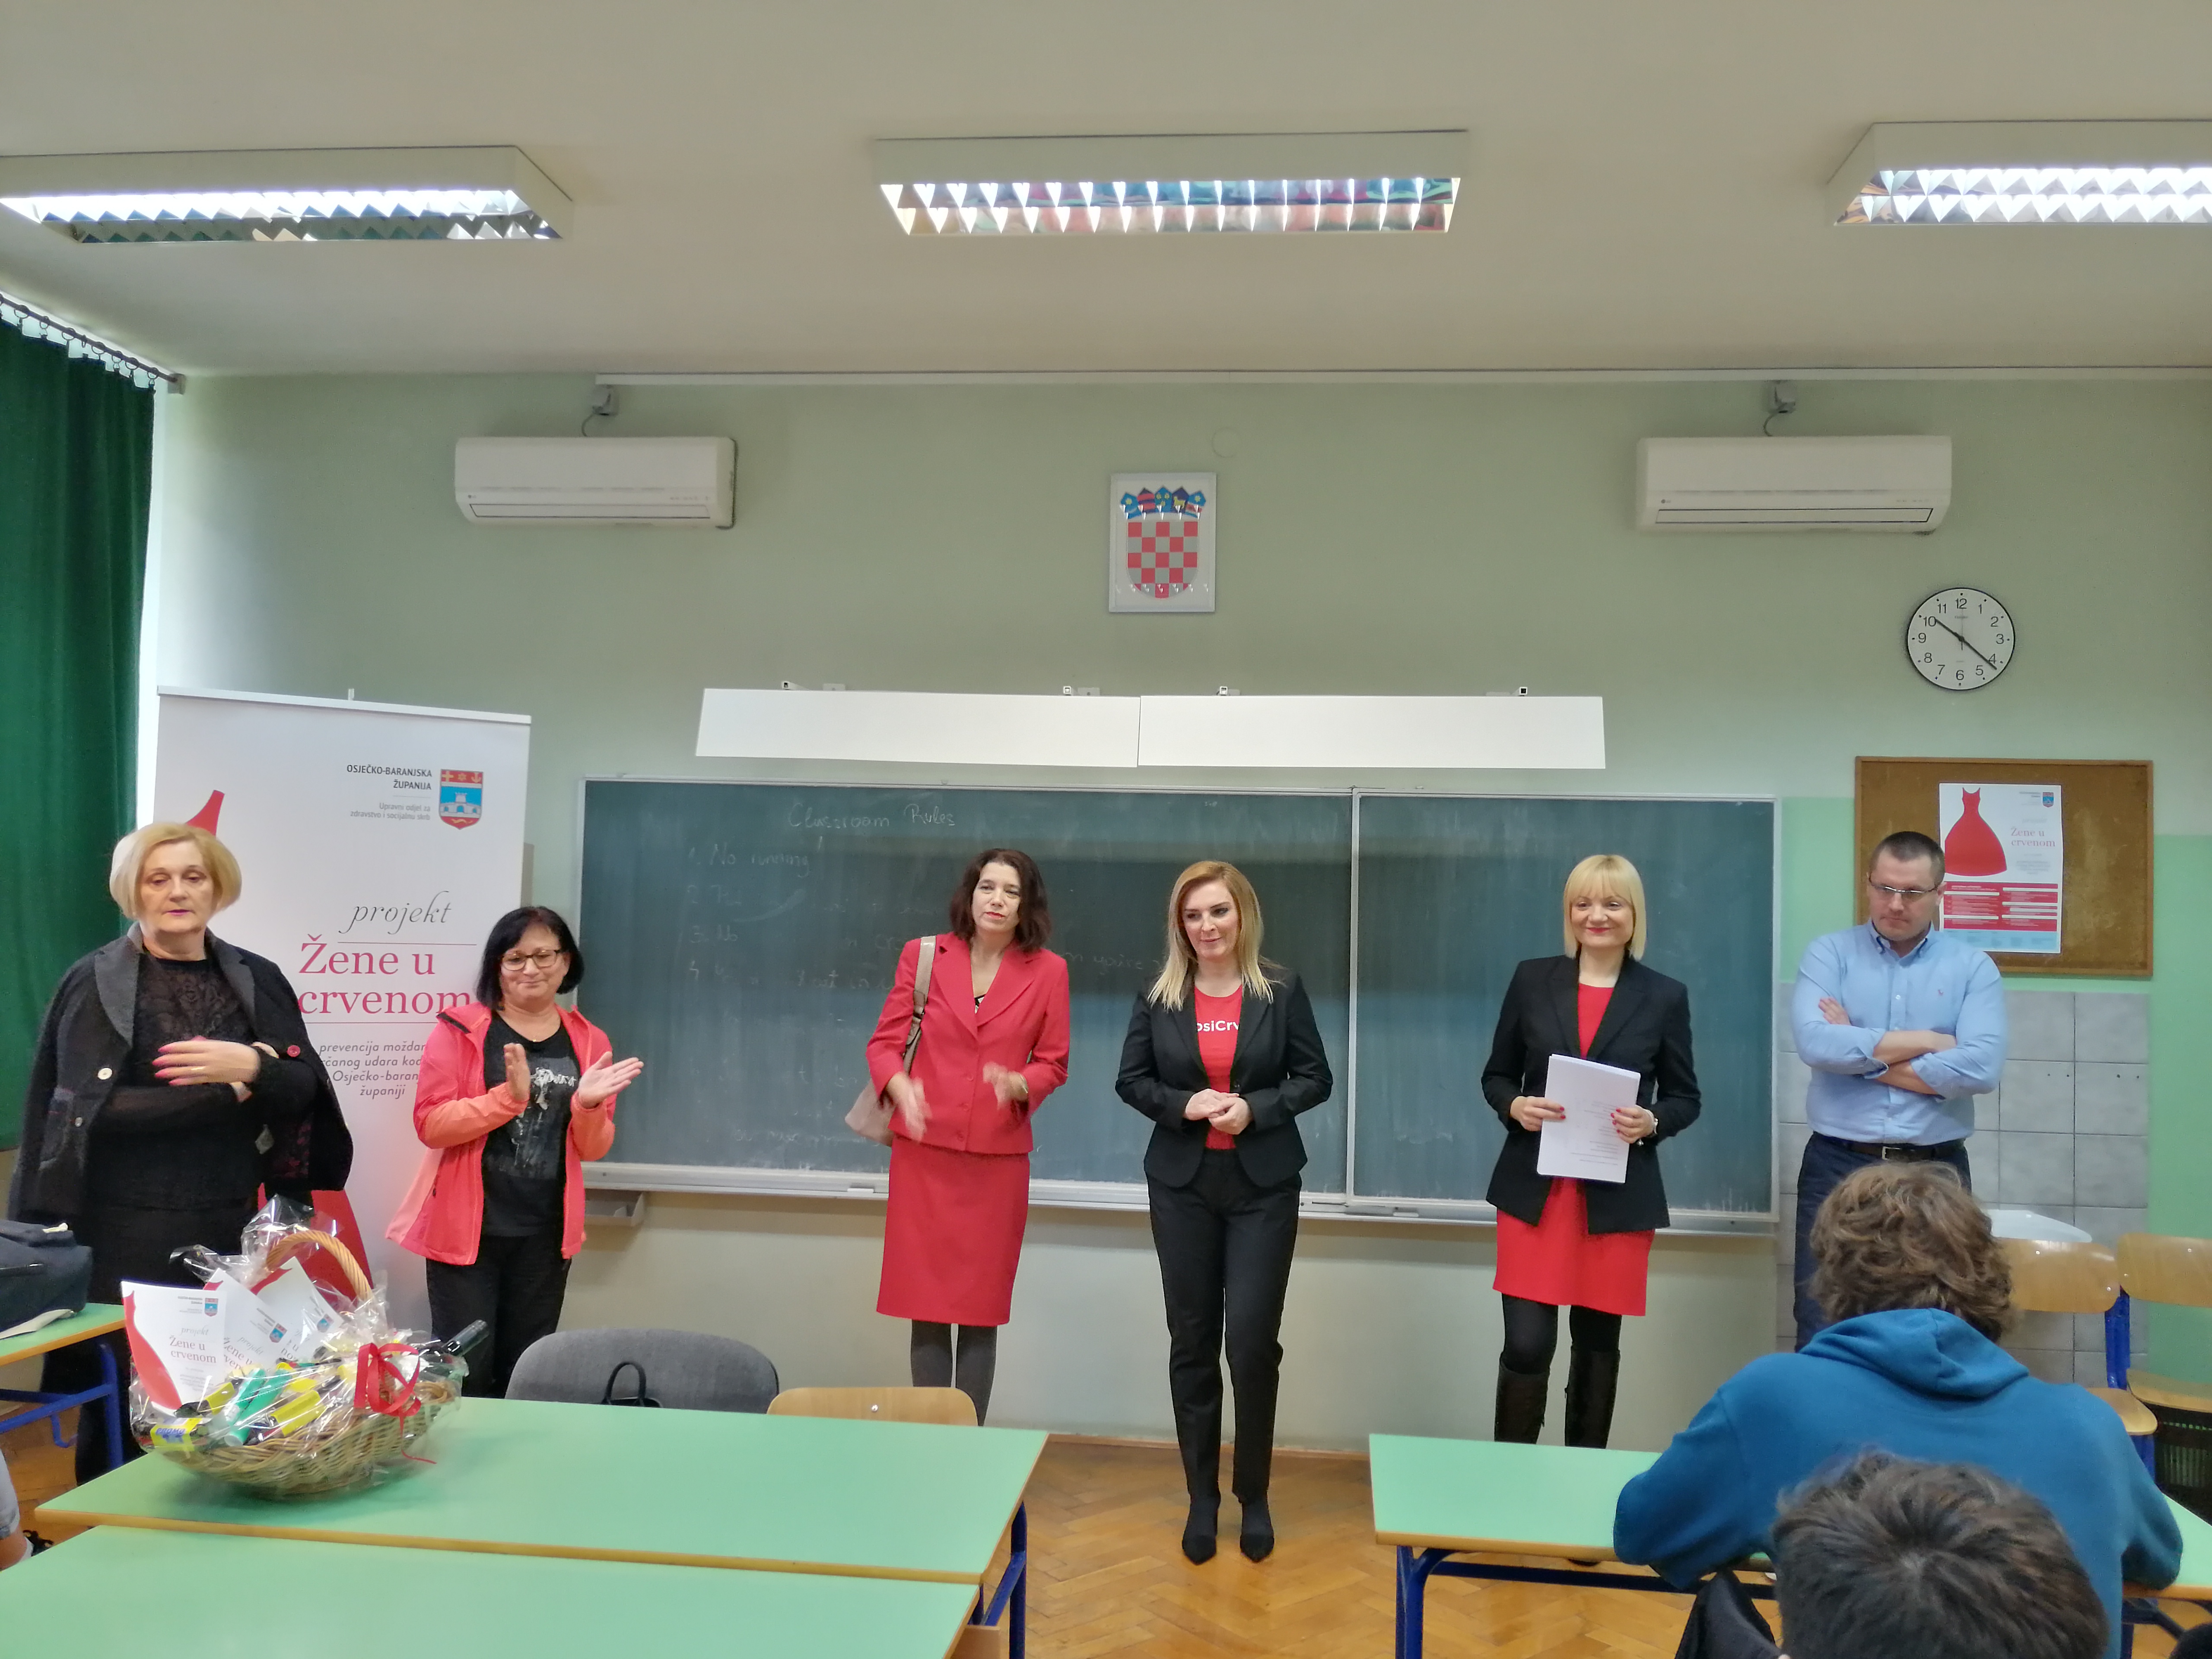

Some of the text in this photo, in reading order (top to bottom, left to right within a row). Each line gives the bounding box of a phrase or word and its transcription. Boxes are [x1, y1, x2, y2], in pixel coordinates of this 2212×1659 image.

[1938, 604, 1946, 613] 11
[1955, 598, 1967, 609] 12
[1979, 604, 1982, 614] 1
[1923, 616, 1936, 626] 10
[1990, 617, 1999, 627] 2
[1918, 632, 1926, 643] 9
[1996, 634, 2004, 644] 3
[1924, 652, 1932, 663] 8
[1988, 654, 1996, 664] 4
[1938, 664, 1945, 675] 7
[1956, 670, 1964, 680] 6
[1976, 665, 1983, 675] 5
[347, 764, 432, 777] OSJEČKO-BARANJSKA
[379, 803, 404, 811] Upravni
[2011, 826, 2035, 836] Žene
[338, 890, 451, 934] projekt
[299, 934, 435, 975] Žene u
[298, 992, 470, 1014] crvenom
[319, 1041, 379, 1056] prevencija
[365, 1055, 397, 1066] udara
[333, 1070, 419, 1085] Osječko-baran
[360, 1084, 406, 1100] županiji
[181, 1325, 209, 1336] projekt
[169, 1335, 195, 1349] Žene
[238, 1337, 264, 1355] projekt
[171, 1351, 216, 1363] crvenom
